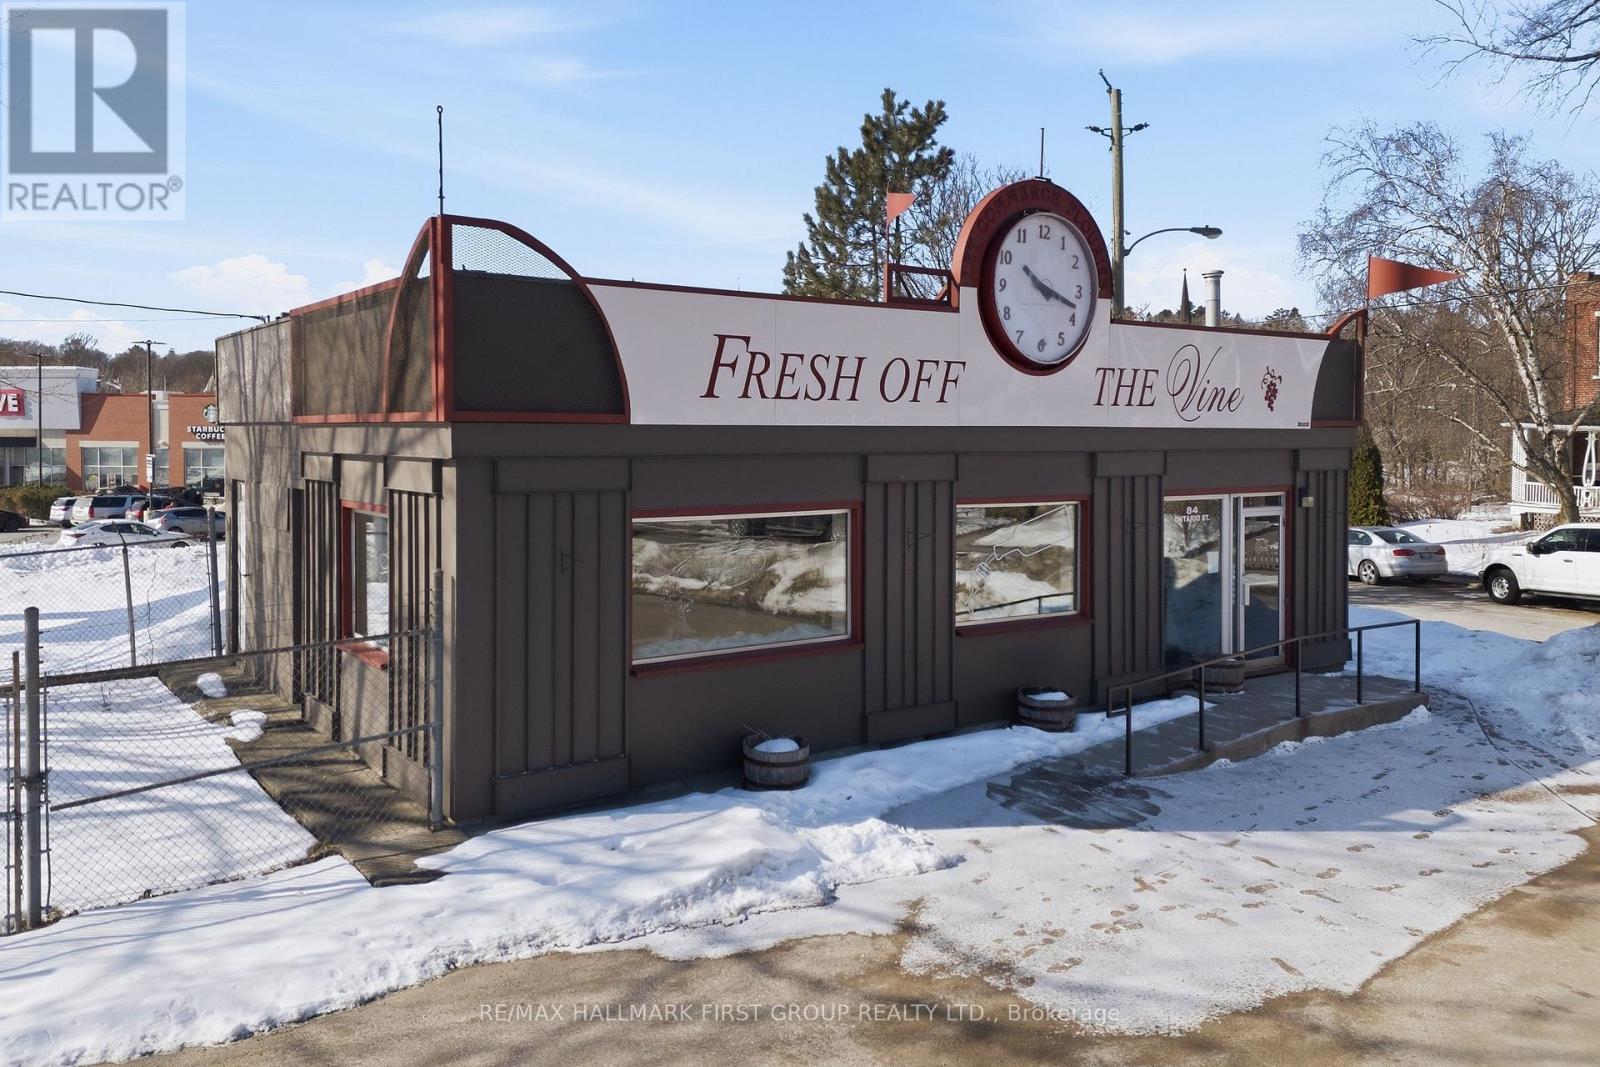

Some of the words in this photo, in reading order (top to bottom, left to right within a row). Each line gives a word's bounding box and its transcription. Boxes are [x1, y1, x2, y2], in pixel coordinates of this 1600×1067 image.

[1016, 228, 1027, 244] 11
[1039, 224, 1051, 240] 12
[1060, 236, 1066, 250] 1
[999, 250, 1013, 265] 10
[1071, 255, 1079, 270] 2
[998, 278, 1007, 292] 9
[1075, 285, 1083, 299] 3
[1003, 306, 1011, 320] 8
[1069, 312, 1076, 326] 4
[1015, 330, 1024, 344] 7
[1057, 332, 1065, 346] 5
[1037, 338, 1047, 352] 6
[700, 333, 867, 401] FRESH
[879, 357, 966, 403] OFF
[1093, 367, 1159, 407] THE
[1166, 344, 1245, 422] Vine
[1186, 506, 1198, 515] 84
